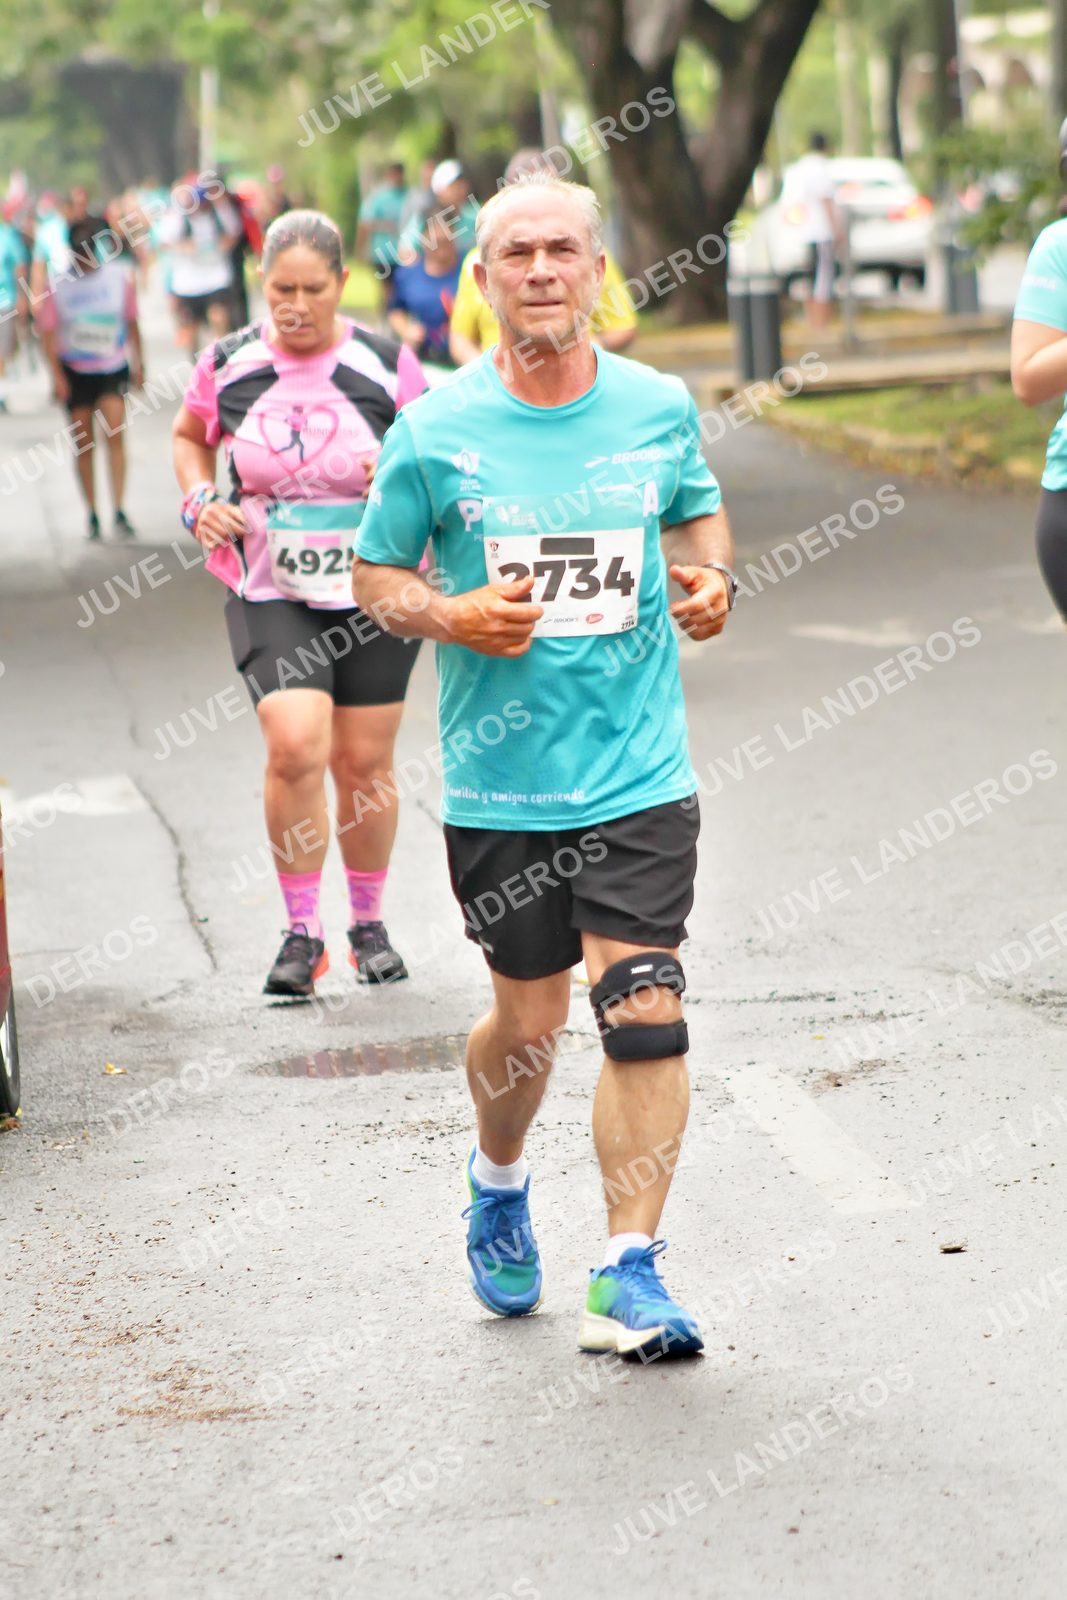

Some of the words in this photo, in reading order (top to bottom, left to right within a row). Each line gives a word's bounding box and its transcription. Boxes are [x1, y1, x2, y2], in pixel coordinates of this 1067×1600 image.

[611, 449, 661, 465] BROOKS
[276, 547, 352, 576] 492
[498, 556, 635, 604] 2734
[492, 792, 527, 805] amigos
[530, 788, 585, 804] corriendo
